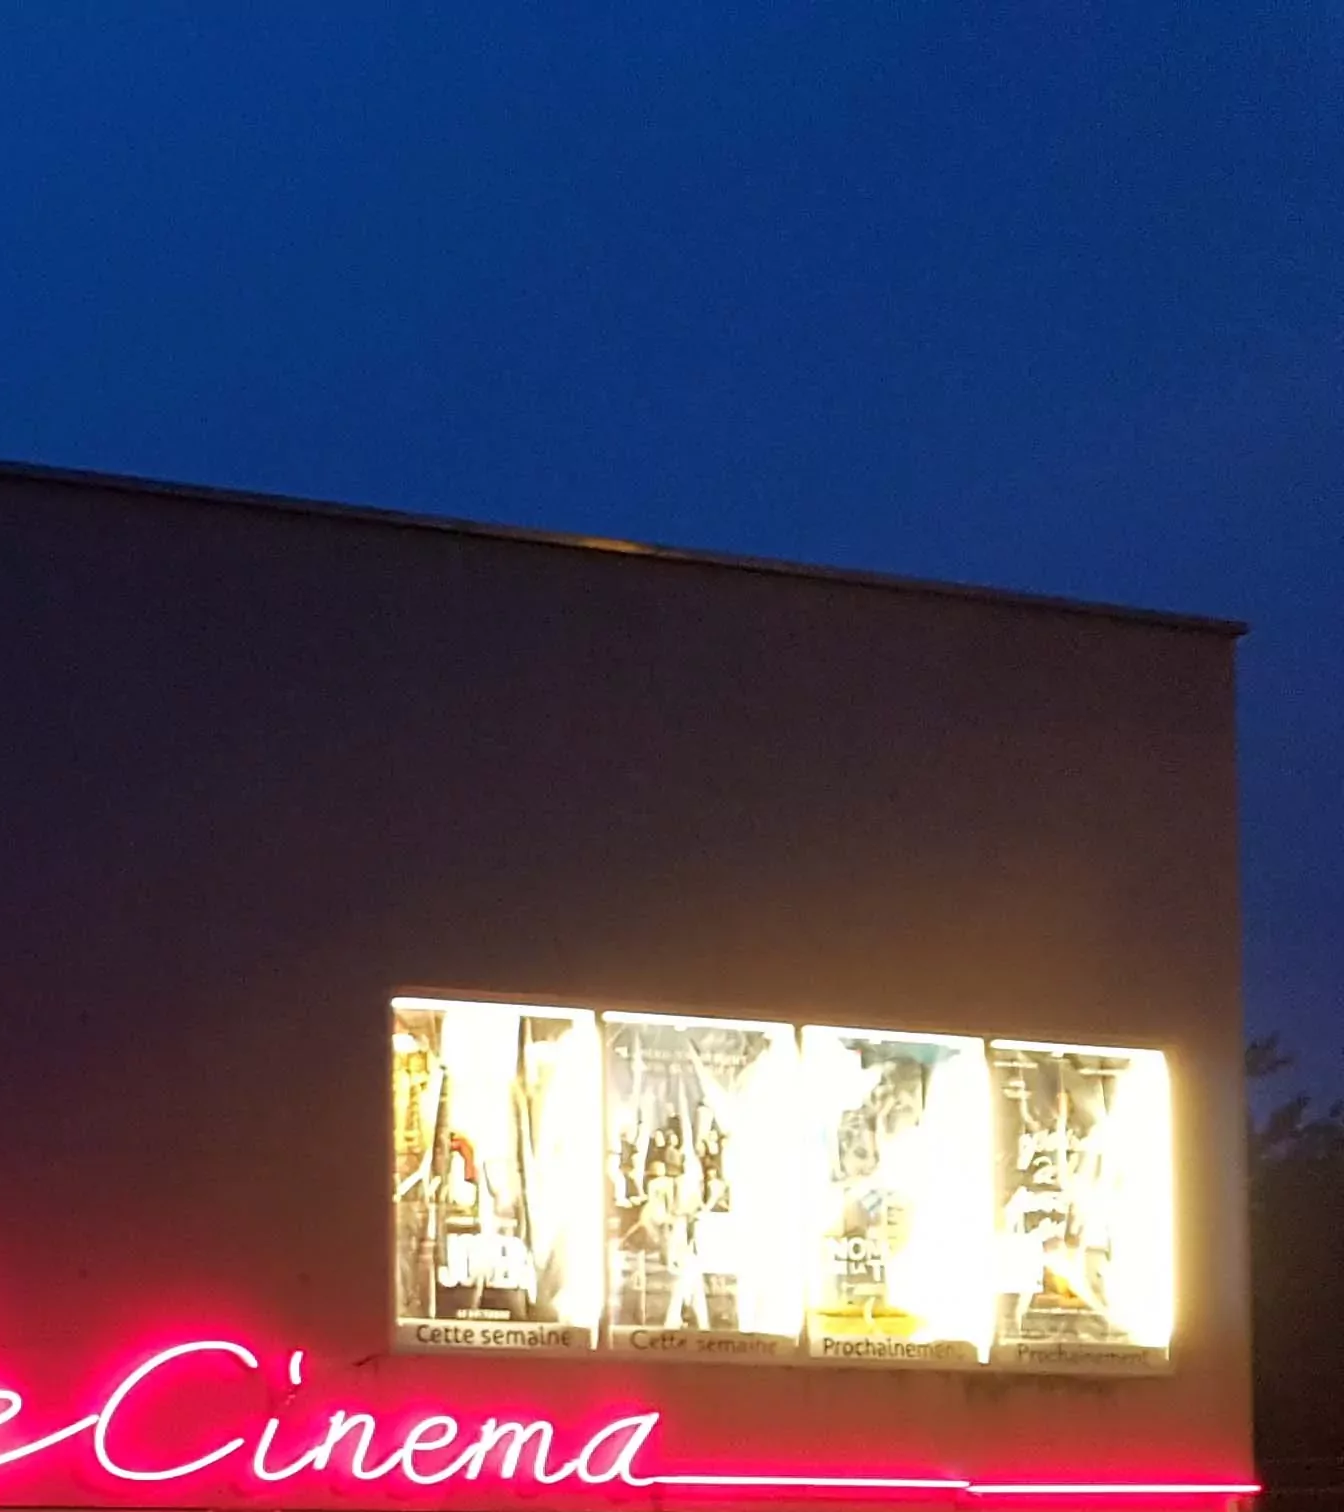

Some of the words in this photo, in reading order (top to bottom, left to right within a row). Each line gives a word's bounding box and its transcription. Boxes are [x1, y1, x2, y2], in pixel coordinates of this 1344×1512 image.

[416, 1324, 474, 1344] Cette
[481, 1327, 570, 1347] semaine
[630, 1329, 687, 1350] Cette
[823, 1337, 965, 1360] Prochainemen
[92, 1338, 662, 1486] Cinema
